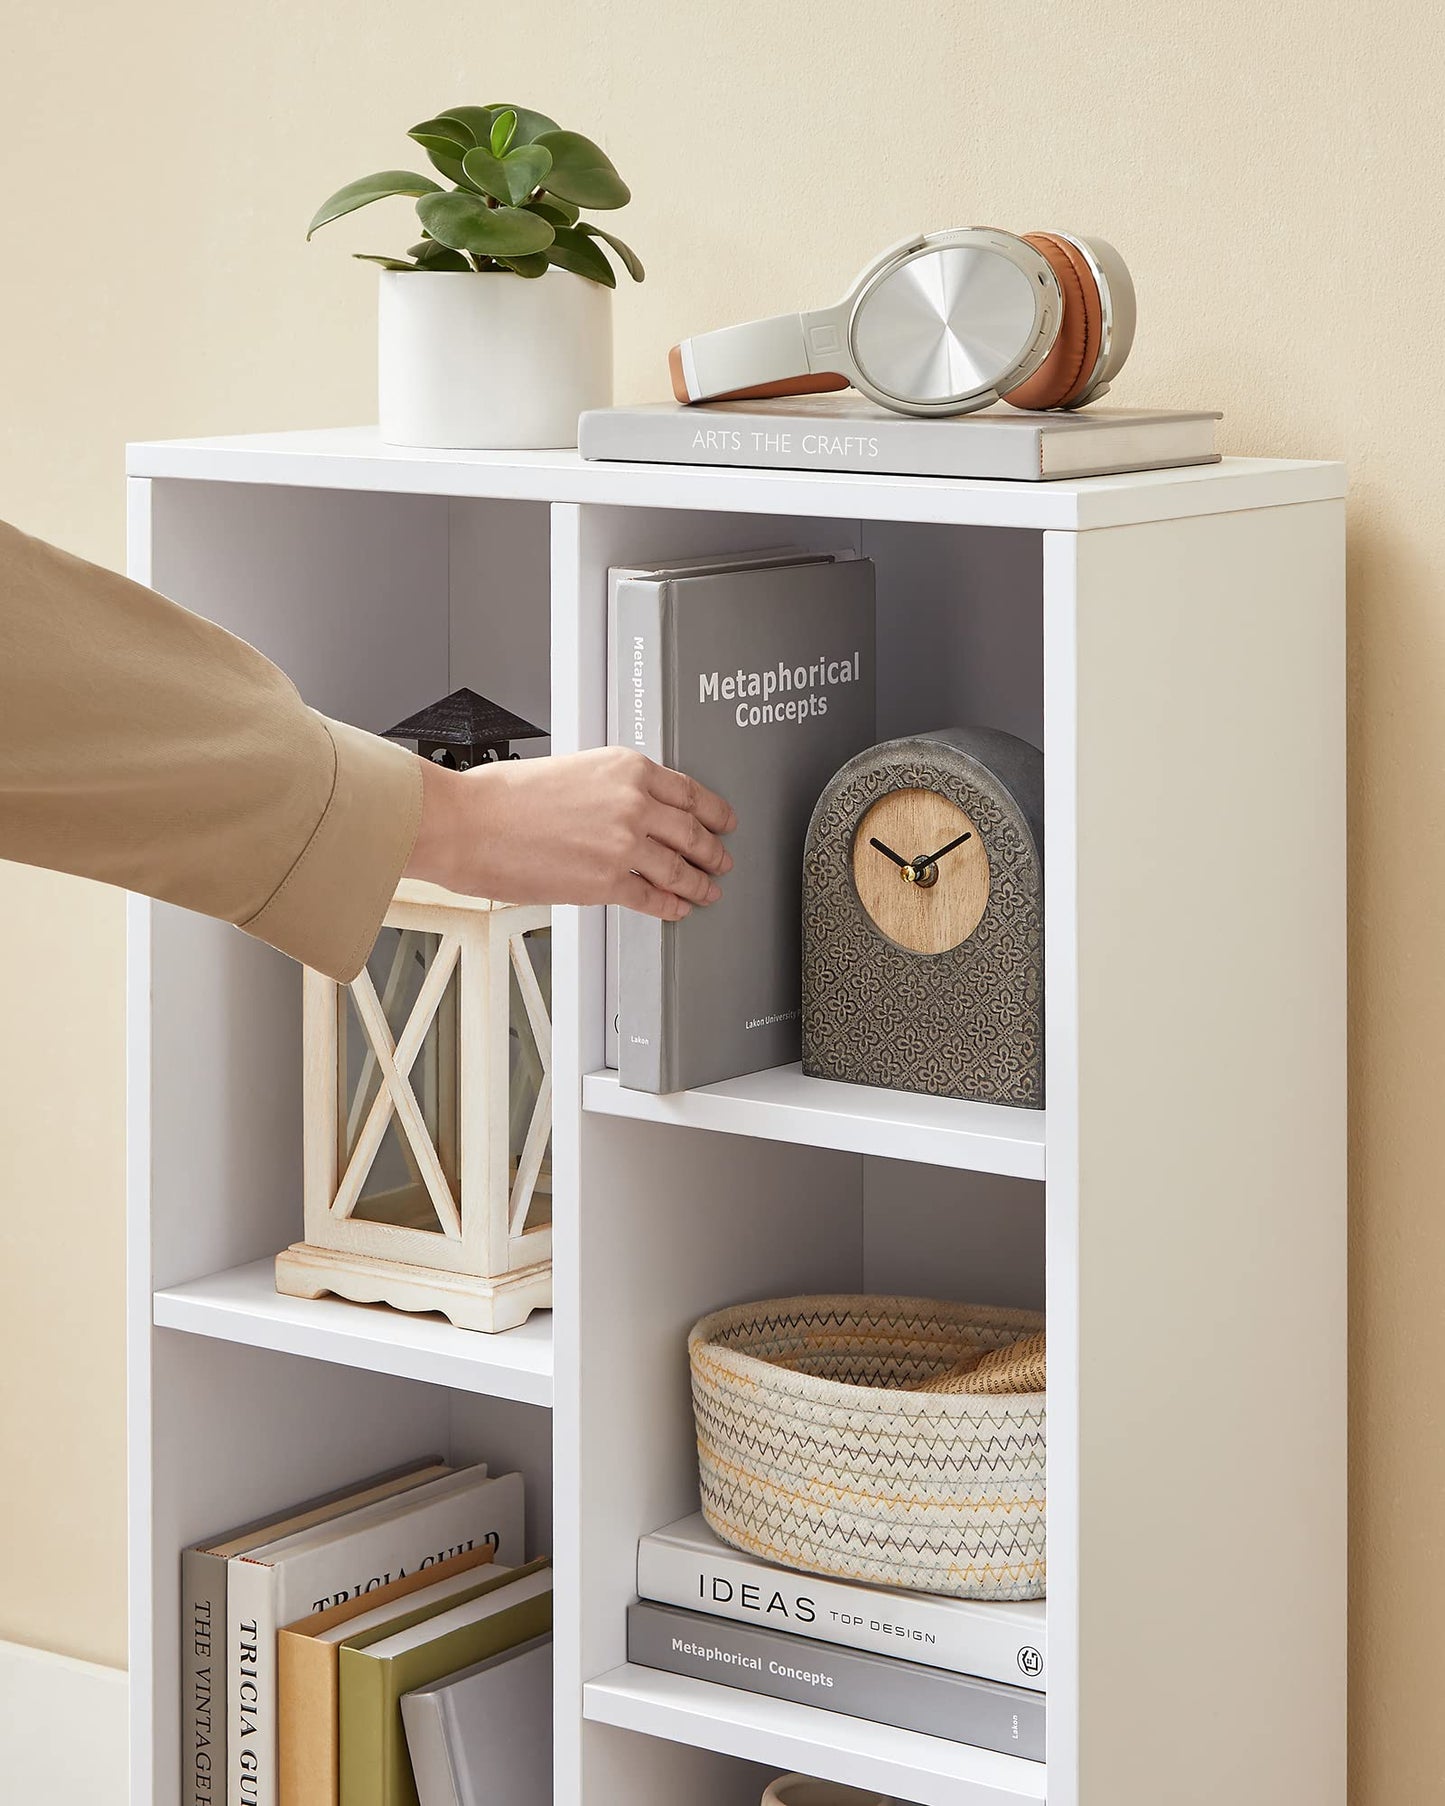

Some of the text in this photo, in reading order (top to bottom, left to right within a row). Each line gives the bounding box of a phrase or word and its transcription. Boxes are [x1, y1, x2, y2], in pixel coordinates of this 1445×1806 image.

[692, 429, 880, 457] ARTS THE CRAFTS
[631, 636, 646, 747] Metaphorical
[699, 651, 860, 703] Metaphorical
[735, 693, 828, 728] Concepts
[630, 1034, 650, 1046] Lakon
[745, 1018, 765, 1030] Lakon
[765, 1009, 797, 1025] University
[194, 1600, 212, 1657] THE
[698, 1573, 937, 1645] IDEAS TOP DESIGN
[240, 1618, 258, 1738] TRICIA
[671, 1638, 834, 1687] Metaphorical Concepts
[194, 1666, 212, 1790] VINTAGE
[1011, 1714, 1019, 1739] Lakon
